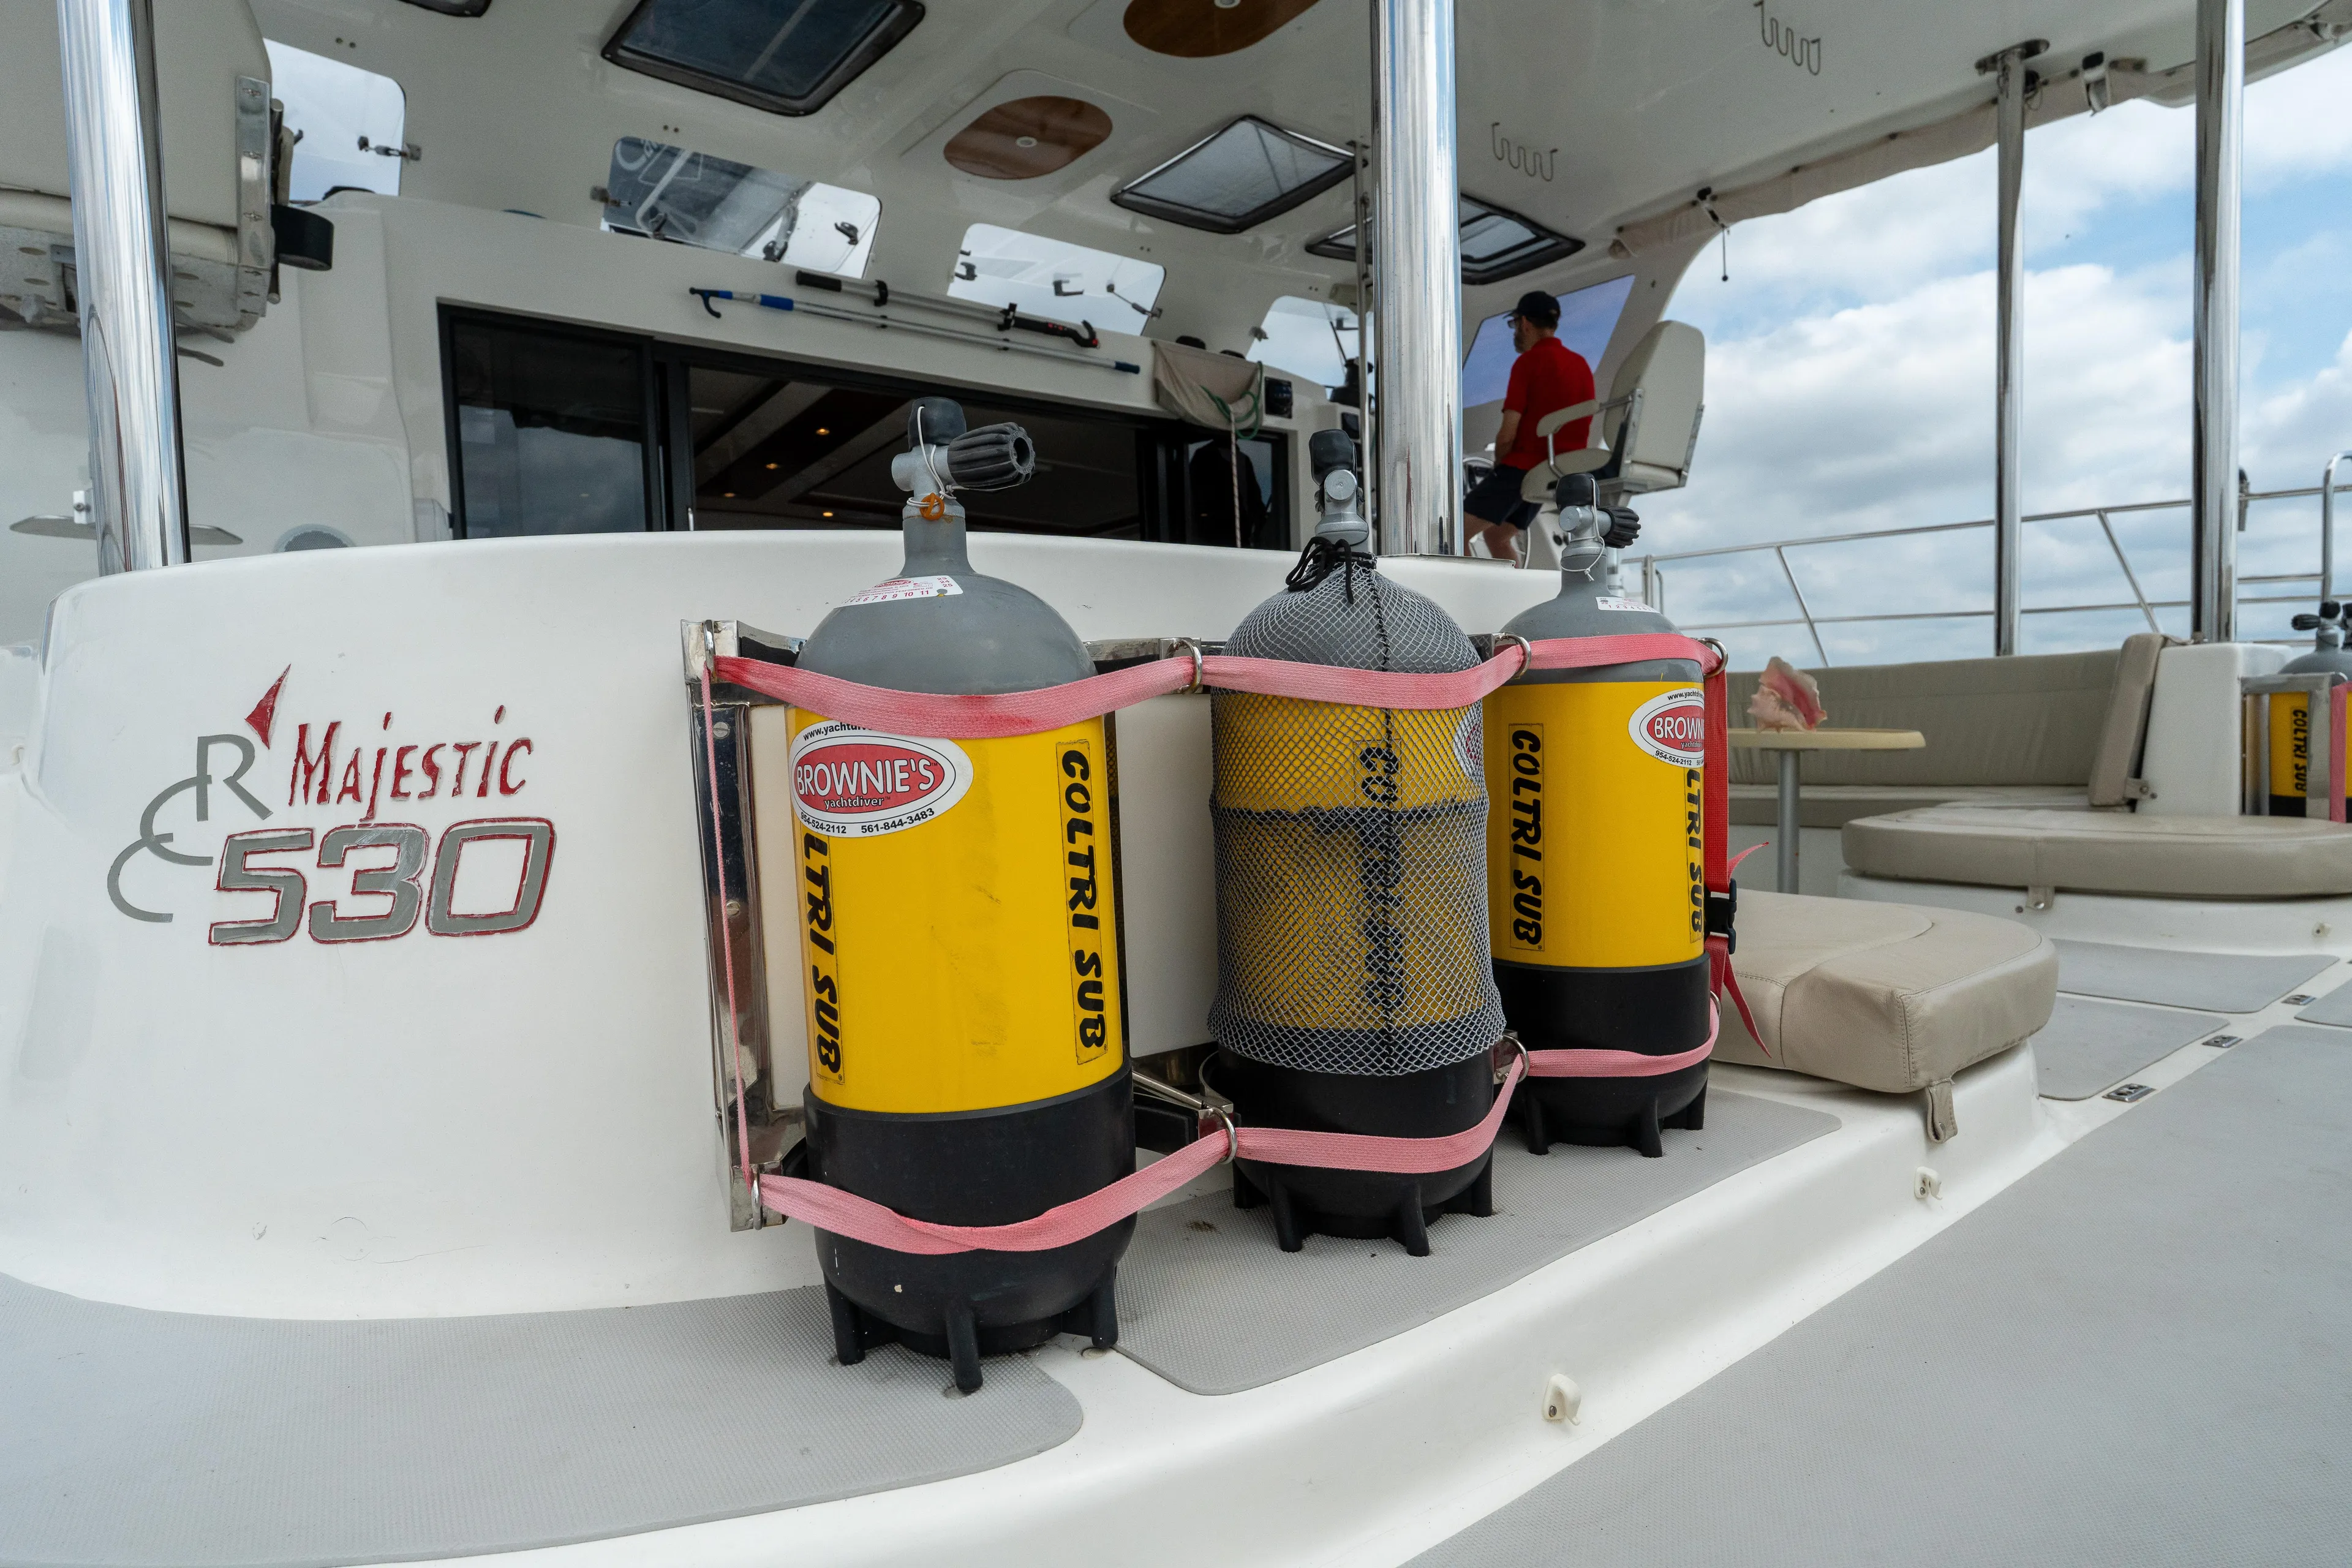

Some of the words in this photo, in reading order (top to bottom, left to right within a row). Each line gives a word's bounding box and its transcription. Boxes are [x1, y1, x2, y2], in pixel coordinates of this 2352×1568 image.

[796, 758, 935, 796] BROWNIE'S
[1511, 729, 1542, 862] COLTRI
[1655, 750, 1692, 766] 954-524-2112
[801, 812, 846, 834] 954-524-2112
[824, 796, 884, 810] yachtdiver
[861, 807, 935, 834] 561-844-3483
[1061, 750, 1099, 930] COLTRI
[1687, 769, 1702, 850] LTRI
[208, 817, 557, 946] 530
[804, 832, 835, 956] LTRI
[1513, 869, 1542, 946] SUB
[1689, 862, 1703, 933] SUB
[812, 964, 842, 1074] SUB
[1074, 949, 1106, 1049] SUB
